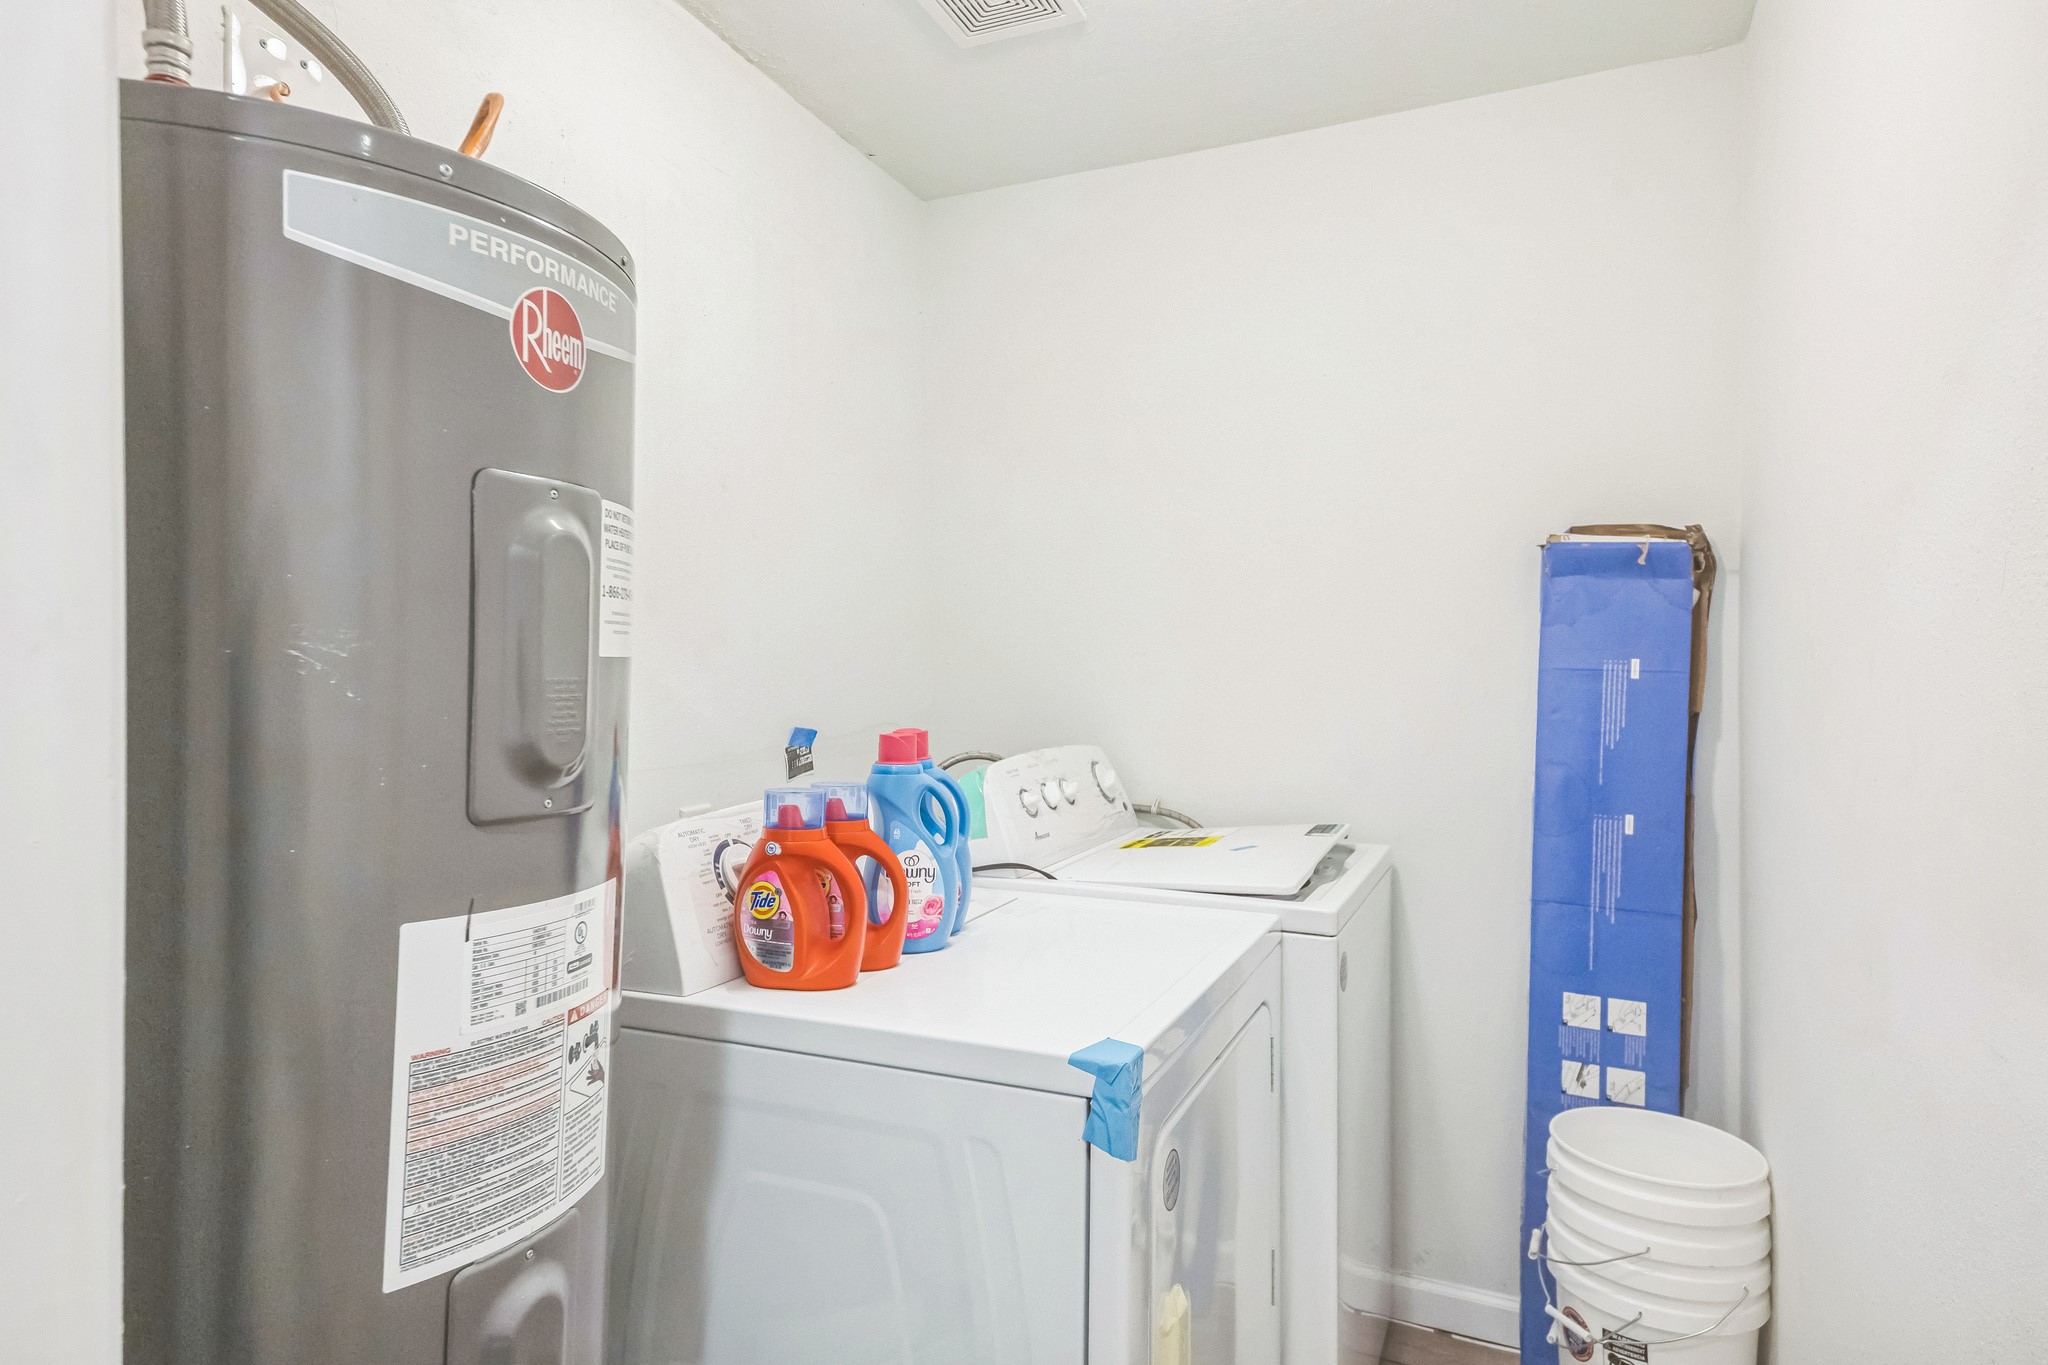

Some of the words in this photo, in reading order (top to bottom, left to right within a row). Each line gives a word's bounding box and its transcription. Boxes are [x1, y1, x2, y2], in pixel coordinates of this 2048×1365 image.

[448, 222, 618, 314] PERFORMANCE
[522, 289, 582, 374] Rheem
[677, 828, 705, 838] AUTOMATIC
[750, 890, 777, 911] Tide
[743, 924, 774, 941] Downy
[411, 1047, 451, 1061] WARNING
